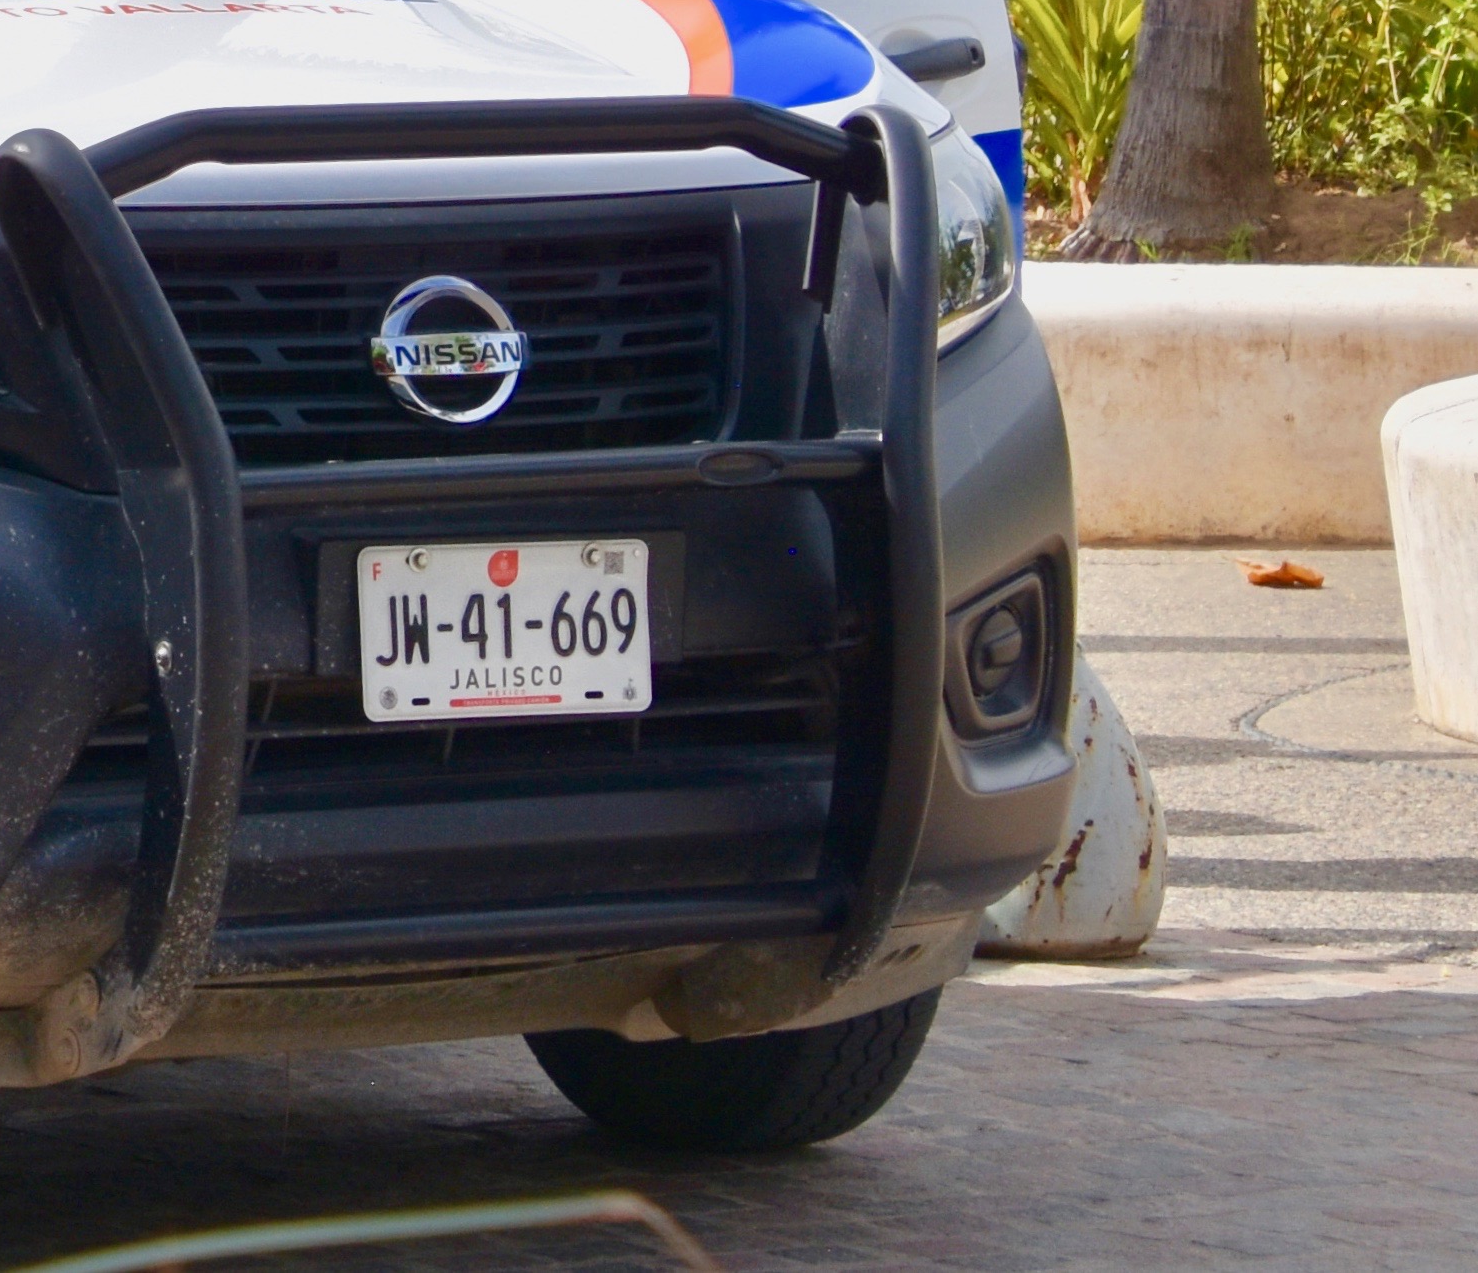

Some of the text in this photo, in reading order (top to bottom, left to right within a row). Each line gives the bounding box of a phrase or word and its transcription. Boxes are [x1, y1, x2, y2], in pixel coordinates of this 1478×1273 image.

[81, 2, 374, 17] VALLARTA
[395, 341, 521, 367] NISSAN
[372, 562, 382, 581] F
[376, 587, 638, 667] JW-41-669
[449, 665, 563, 690] JALISCO
